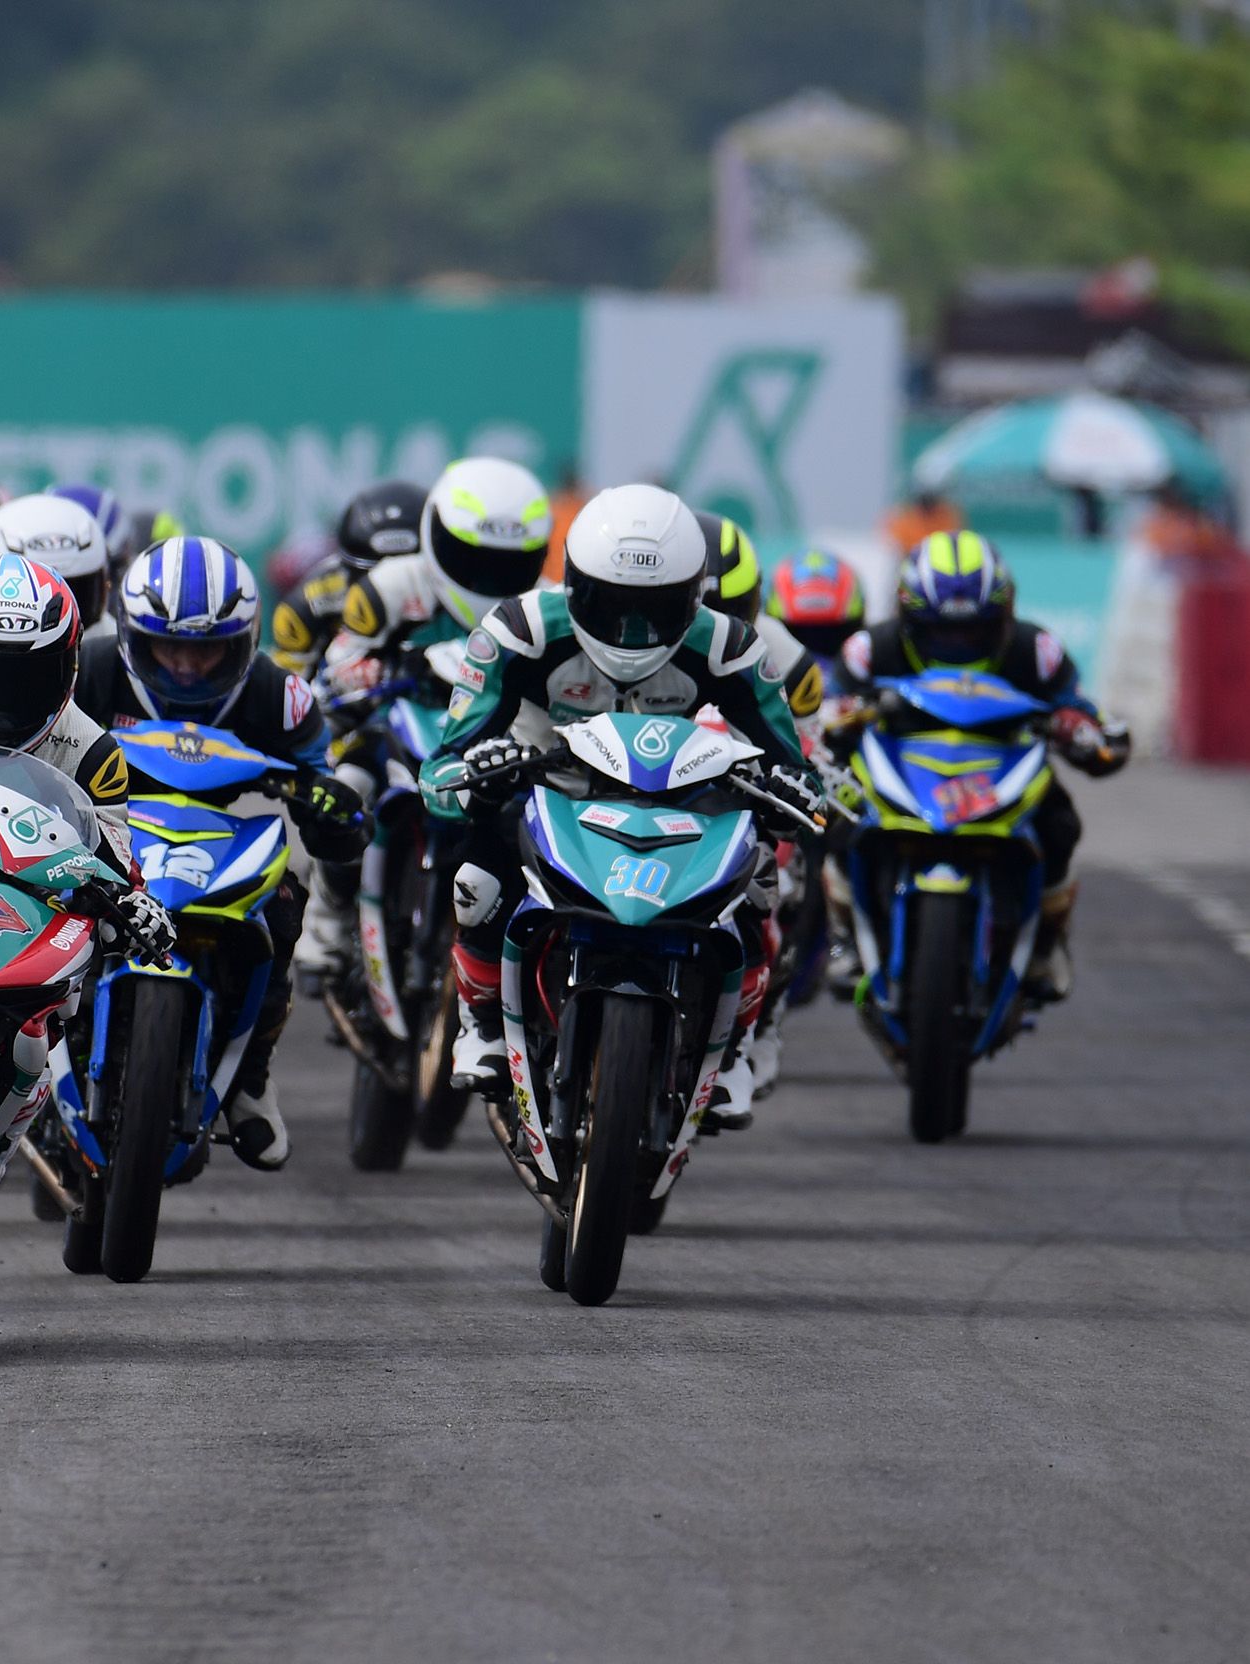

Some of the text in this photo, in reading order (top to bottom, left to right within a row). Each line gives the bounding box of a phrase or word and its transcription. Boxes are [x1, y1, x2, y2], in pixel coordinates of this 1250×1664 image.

[676, 746, 723, 778] PETRONAS
[140, 843, 215, 889] 12
[604, 855, 670, 896] 30
